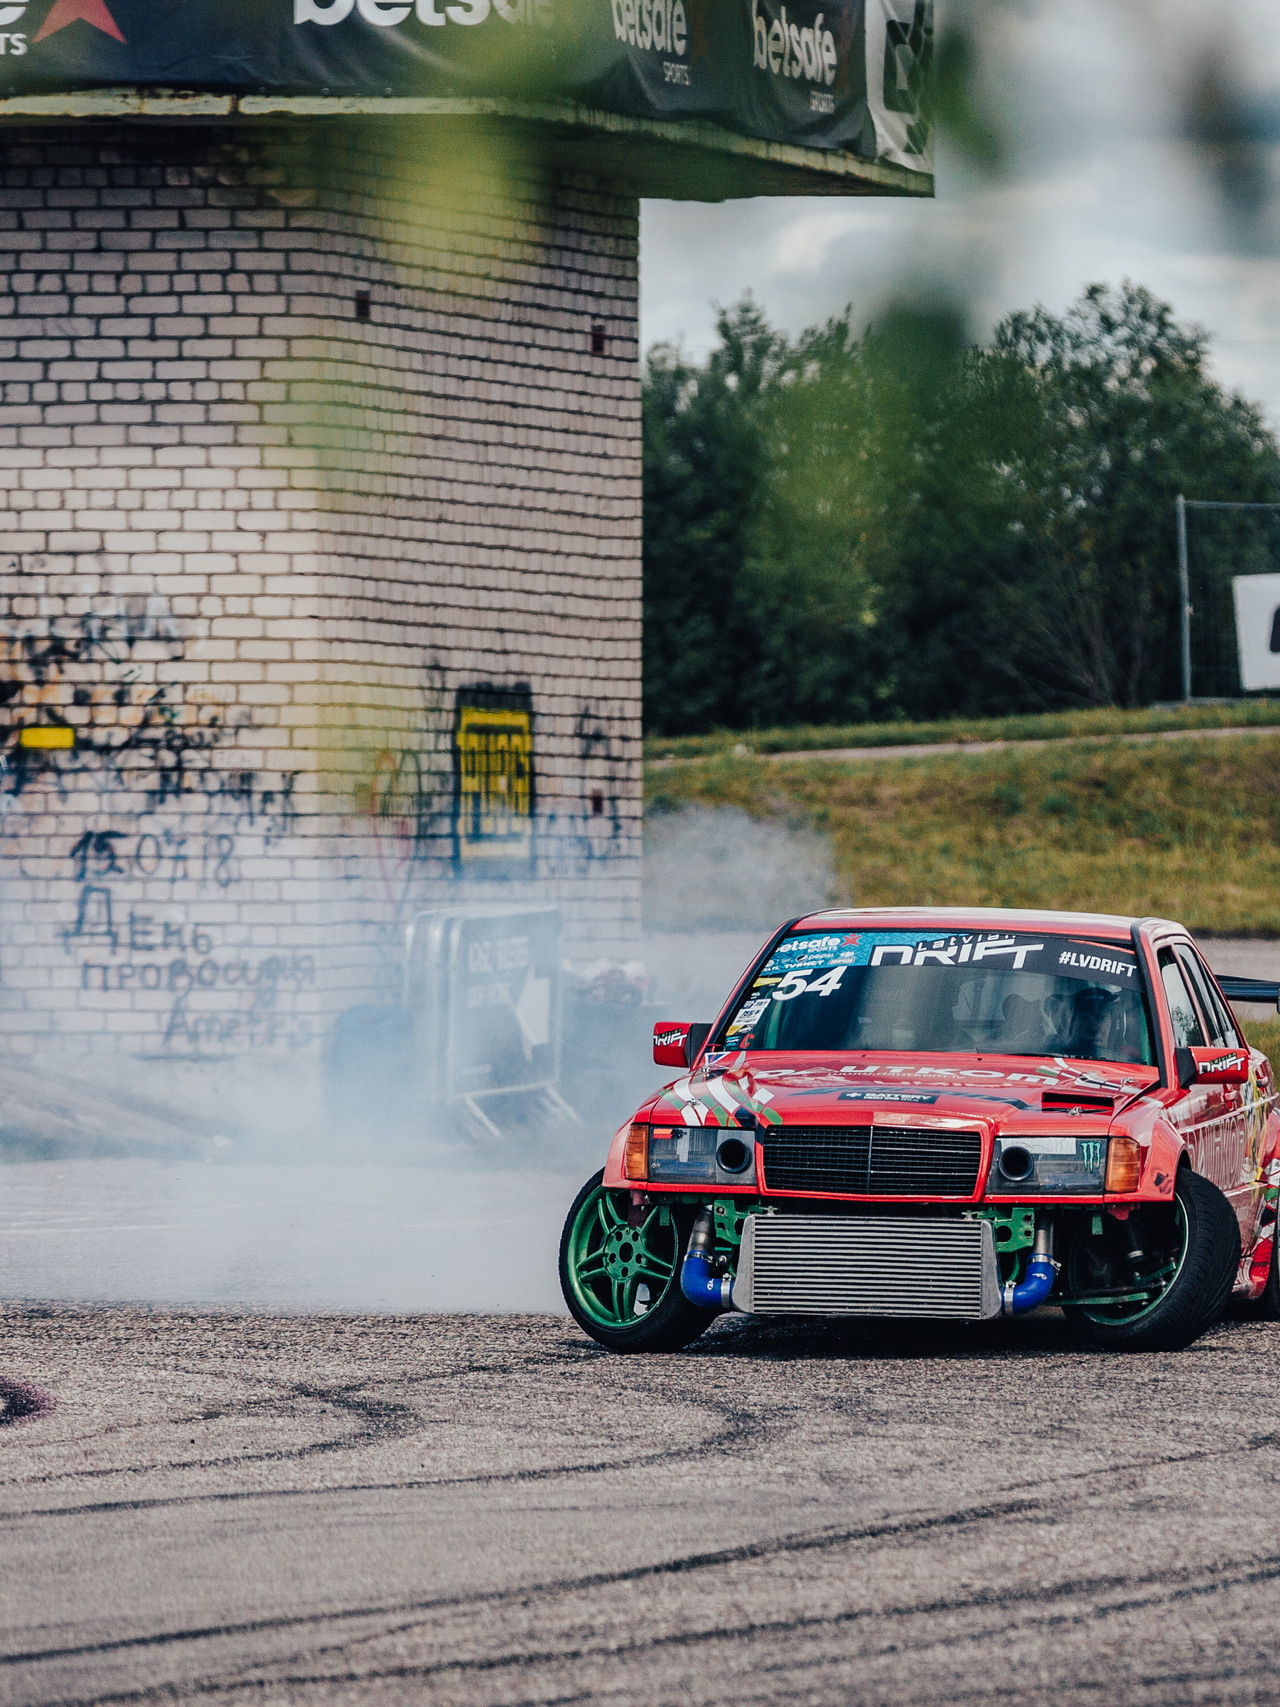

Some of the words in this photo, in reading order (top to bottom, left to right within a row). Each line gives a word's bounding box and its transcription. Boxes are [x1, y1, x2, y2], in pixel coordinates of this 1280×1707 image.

[752, 2, 838, 86] betsafe
[775, 936, 841, 953] etsafe
[1058, 950, 1137, 978] #LVDRIFT
[772, 965, 848, 1000] 54
